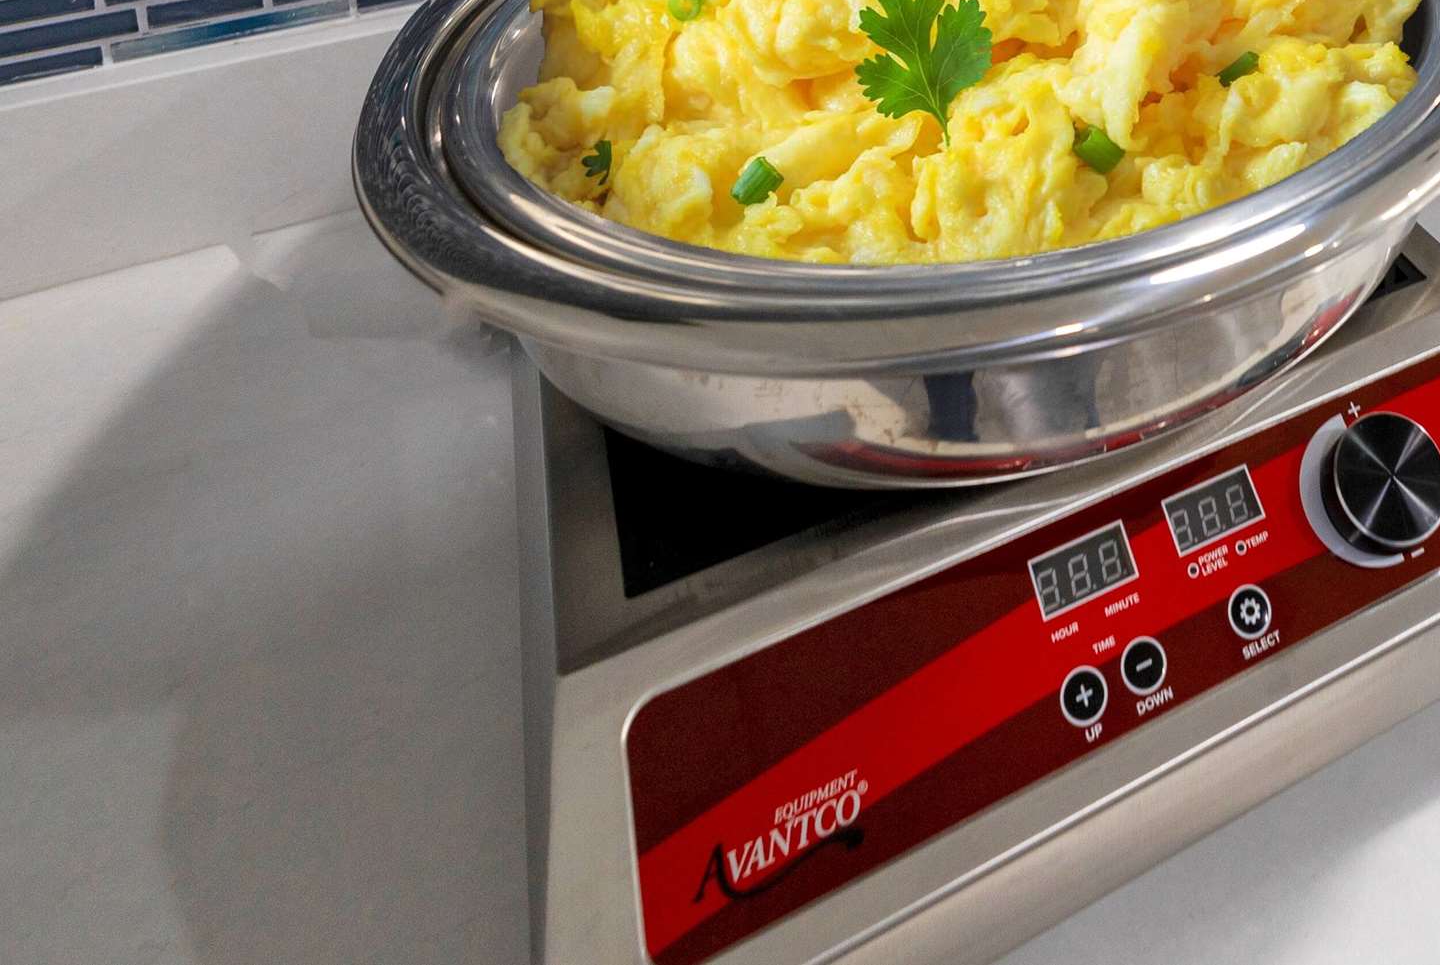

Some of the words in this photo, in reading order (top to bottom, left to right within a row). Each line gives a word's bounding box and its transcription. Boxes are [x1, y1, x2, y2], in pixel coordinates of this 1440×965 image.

[1246, 530, 1269, 549] TEMP
[1198, 544, 1229, 565] POWER
[1201, 557, 1228, 577] LEVEL
[1104, 592, 1140, 617] MINUTE
[1051, 621, 1079, 643] HOUR
[1092, 635, 1116, 655] TIME
[1242, 628, 1280, 660] SELECT
[1136, 686, 1174, 716] DOWN
[1085, 722, 1102, 743] UP
[774, 768, 857, 825] EQUIPMENT
